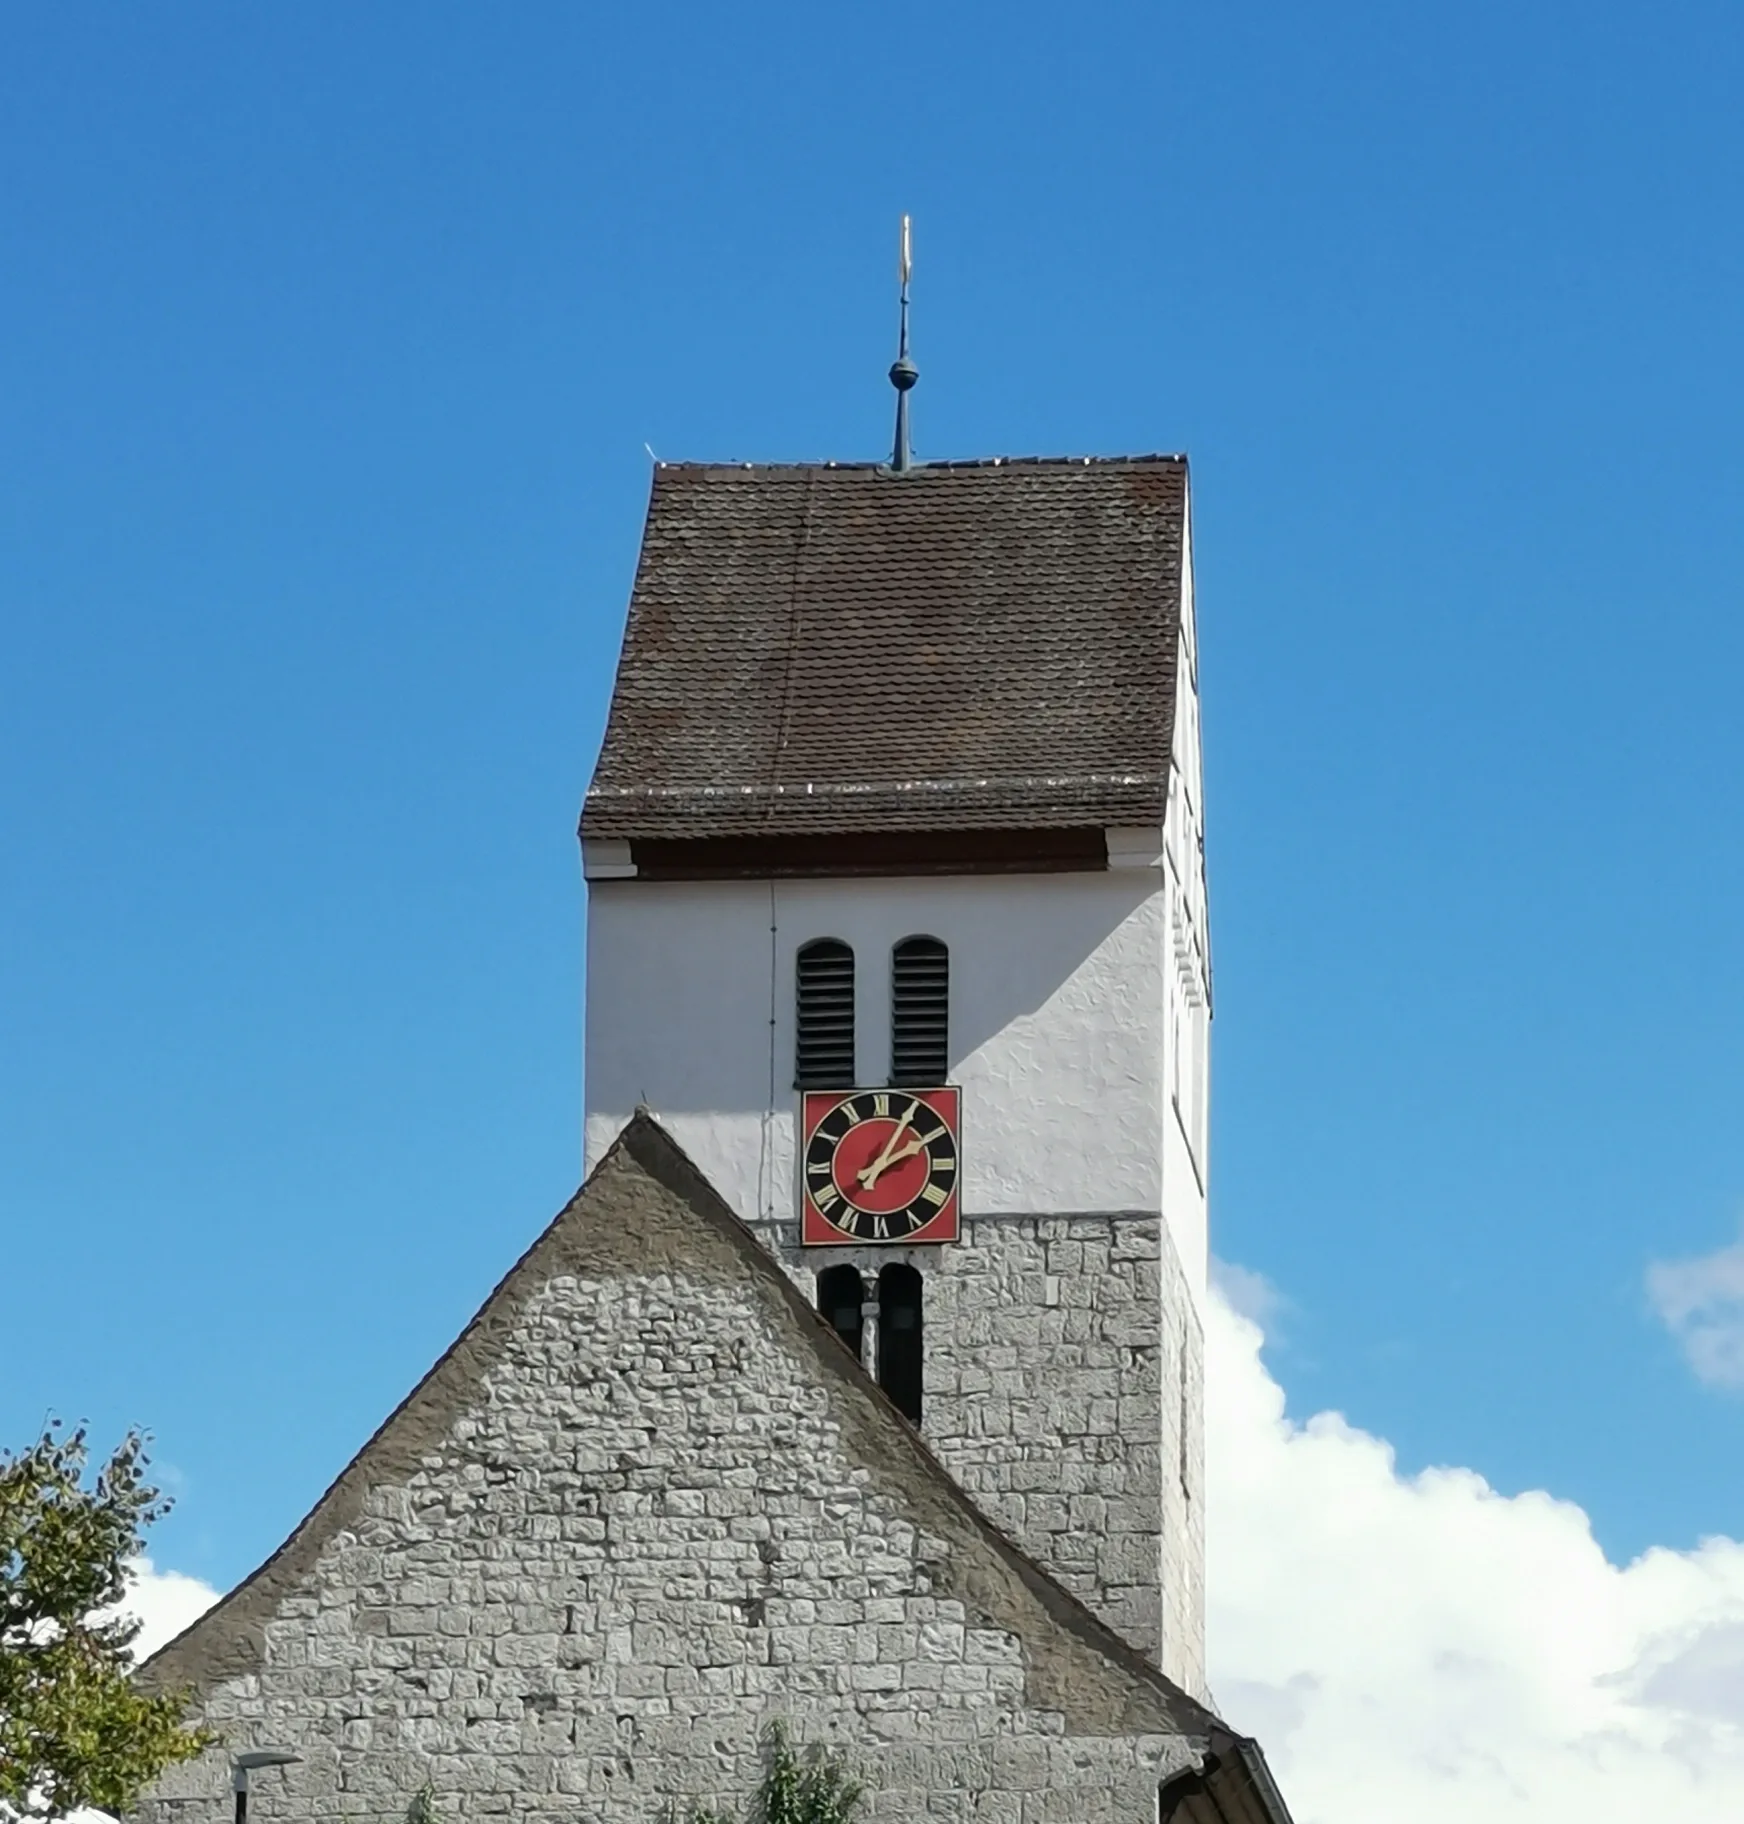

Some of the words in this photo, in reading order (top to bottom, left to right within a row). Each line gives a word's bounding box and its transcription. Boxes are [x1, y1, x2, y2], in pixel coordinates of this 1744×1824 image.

[840, 1102, 861, 1126] XI
[873, 1094, 889, 1117] XII
[815, 1127, 840, 1147] X
[808, 1161, 831, 1175] IX
[932, 1157, 955, 1171] III
[814, 1184, 840, 1214] VIII
[837, 1206, 859, 1234] VII
[873, 1216, 890, 1239] VI
[906, 1209, 923, 1231] V
